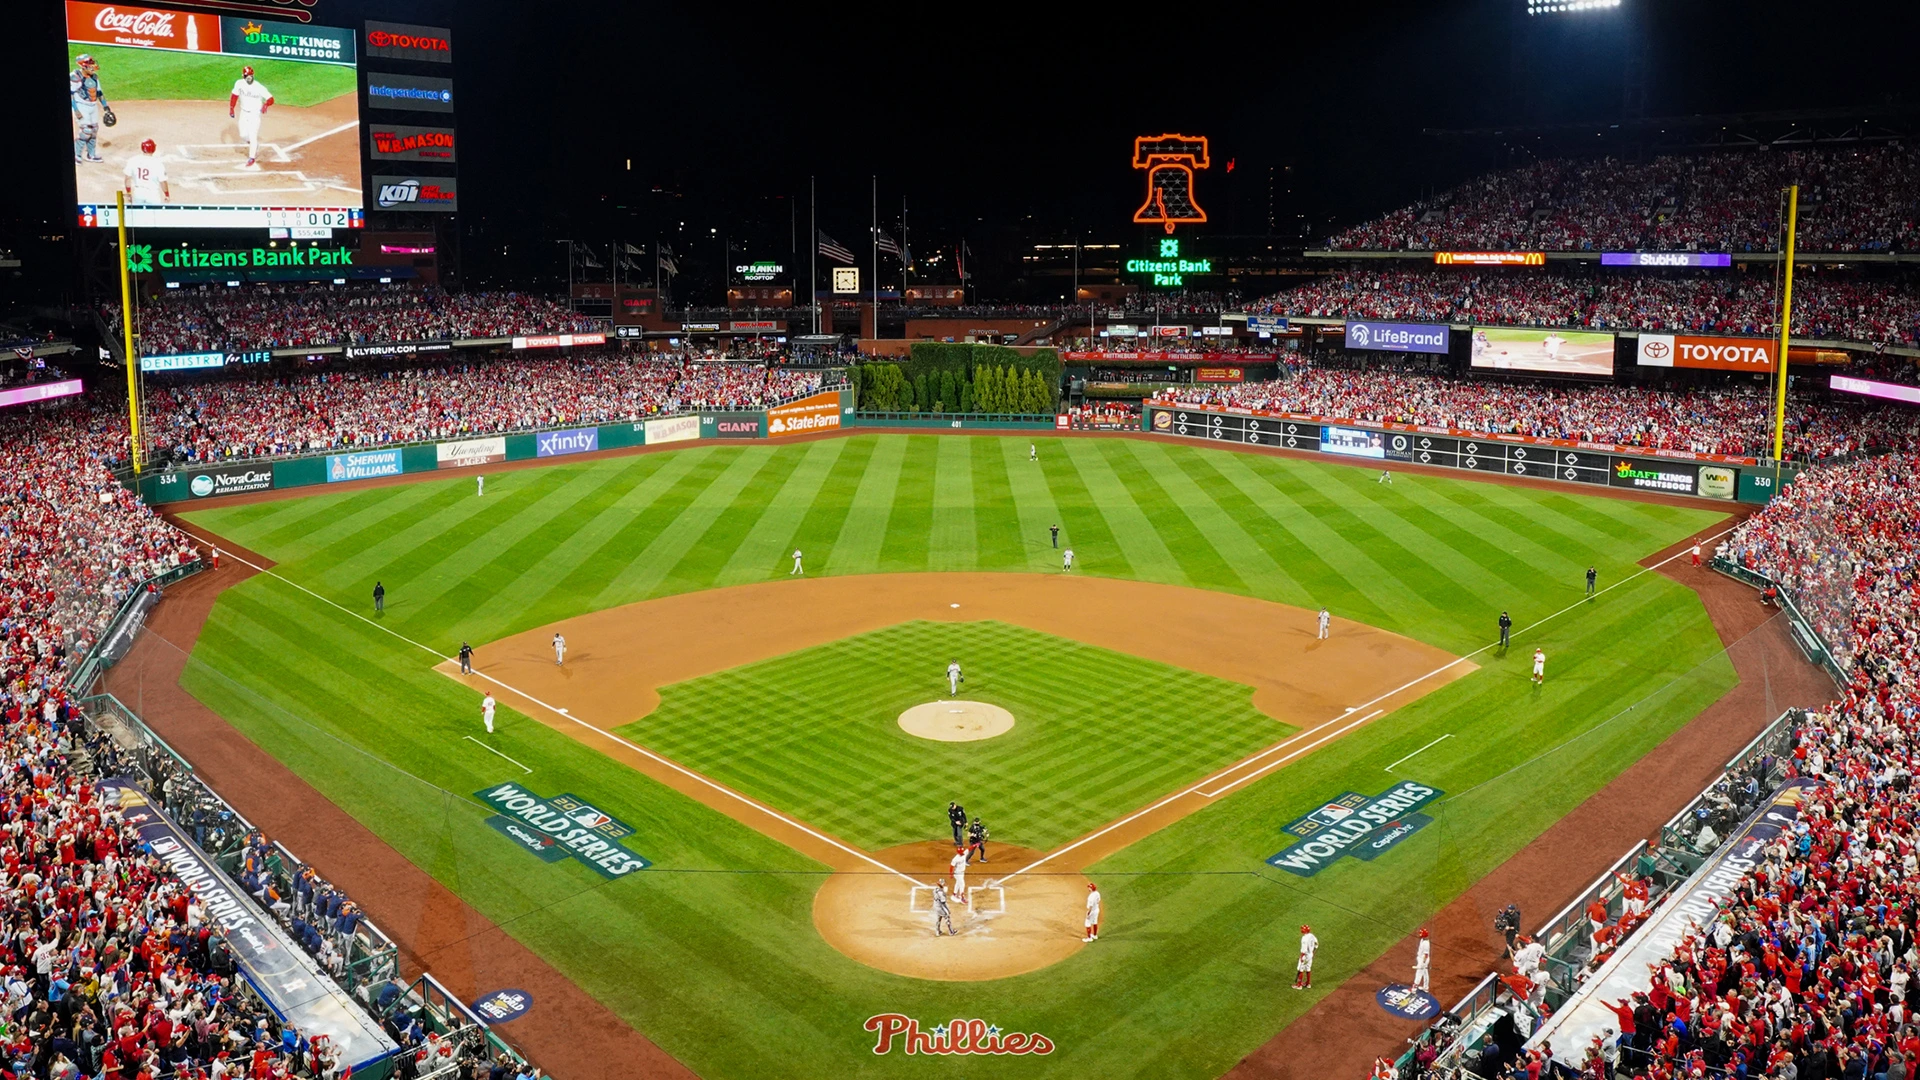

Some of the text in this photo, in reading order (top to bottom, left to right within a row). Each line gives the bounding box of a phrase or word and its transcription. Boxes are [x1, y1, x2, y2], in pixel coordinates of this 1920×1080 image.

[95, 7, 175, 37] Coca-Cola
[245, 32, 341, 50] DRAFTKINGS
[389, 34, 449, 51] TOYOTA
[269, 45, 340, 59] SPORTSBOOK
[369, 85, 438, 100] Independence
[137, 167, 150, 180] 12
[379, 185, 419, 202] KDI
[309, 213, 318, 226] 0
[323, 213, 331, 226] 0
[337, 213, 345, 226] 2
[158, 246, 353, 268] Citizens Bank Park
[1126, 258, 1211, 272] Citizens Bank
[1640, 253, 1689, 266] StubHub
[1154, 273, 1182, 285] Park
[527, 335, 603, 346] TOYOTA TOYOTA
[1374, 329, 1443, 346] LifeBrand
[353, 345, 417, 356] KLYRRUM.COM
[1680, 343, 1769, 365] TOYOTA
[143, 352, 270, 369] DENTISTRY for LIFE
[633, 423, 644, 432] 374
[717, 422, 759, 432] GIANT
[951, 421, 962, 429] 401
[540, 431, 595, 455] xfinity
[1577, 442, 1615, 452] #HITTHEBUDS
[1656, 450, 1696, 460] #HITTHEBUDS
[347, 453, 396, 467] SHERWIN
[457, 456, 487, 466] LAGER
[160, 474, 177, 485] 334
[214, 471, 272, 487] NovaCare
[1617, 468, 1693, 484] DRAFTKINGS
[1754, 477, 1771, 487] 330
[215, 482, 270, 494] REHABILITATION
[1634, 479, 1692, 491] SPORTSBOOK
[553, 798, 624, 838] 20 22
[1294, 795, 1366, 835] 20 22
[488, 785, 644, 875] WORLD SERIES
[1275, 783, 1435, 870] WORLD SERIES
[1703, 853, 1756, 894] SERIES
[162, 848, 217, 892] WORLD
[197, 888, 256, 930] SERIES
[496, 992, 525, 1011] WORLD
[480, 1001, 507, 1019] SERIES
[863, 1012, 1055, 1056] Phillies
